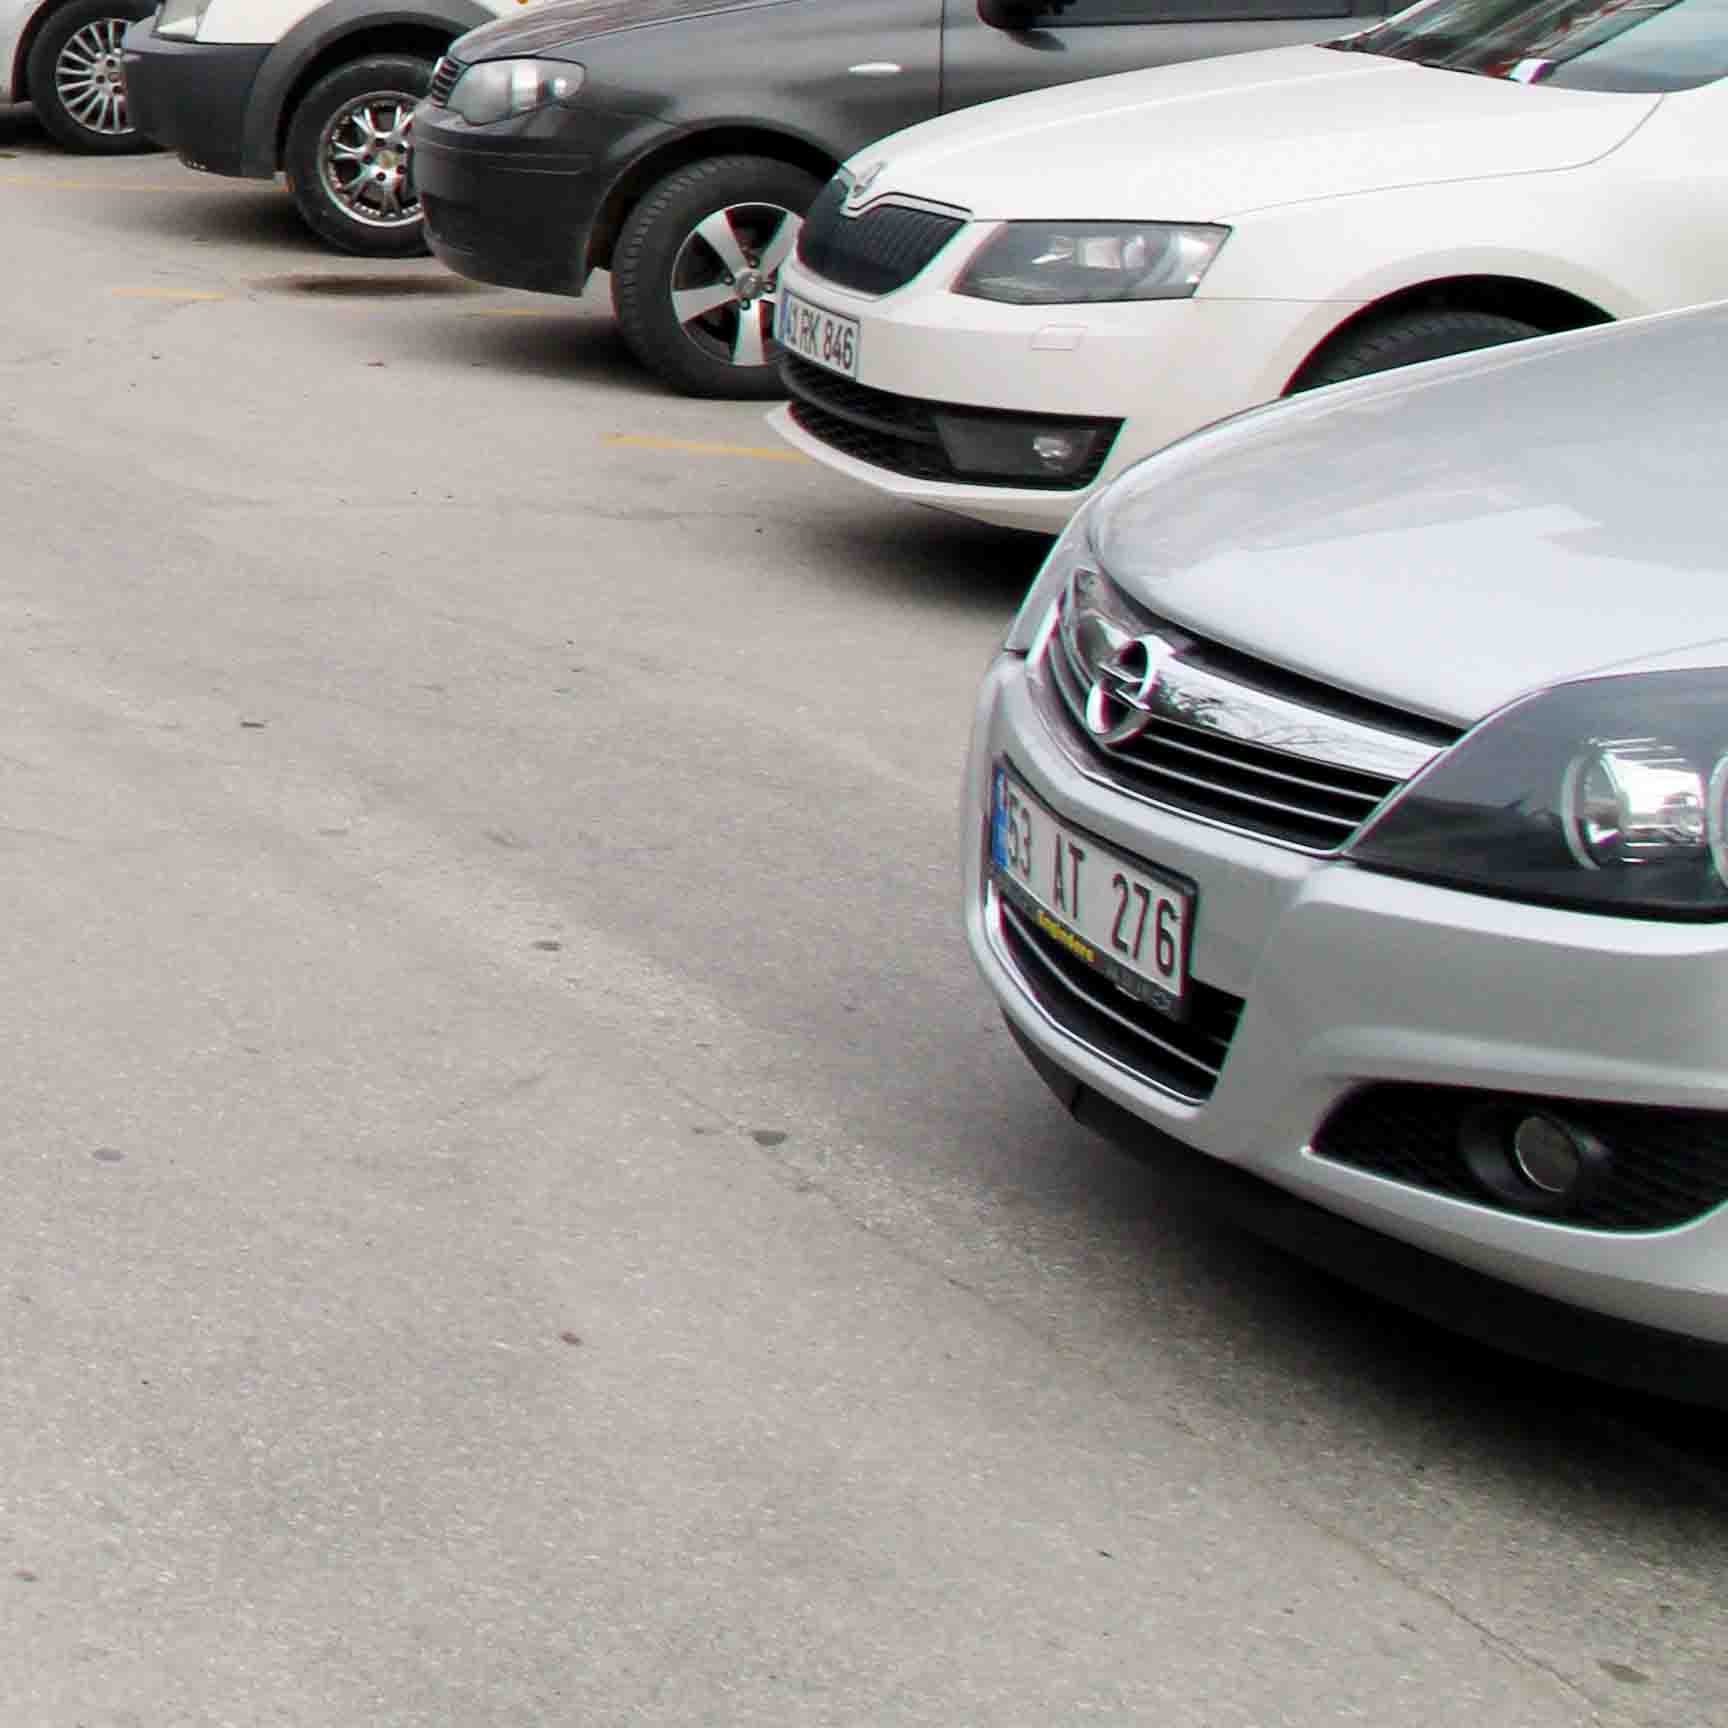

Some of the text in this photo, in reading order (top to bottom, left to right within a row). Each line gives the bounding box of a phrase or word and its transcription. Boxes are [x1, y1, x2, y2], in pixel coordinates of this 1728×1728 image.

[824, 319, 854, 370] 846
[1053, 832, 1086, 921] AT
[1111, 872, 1180, 978] 276
